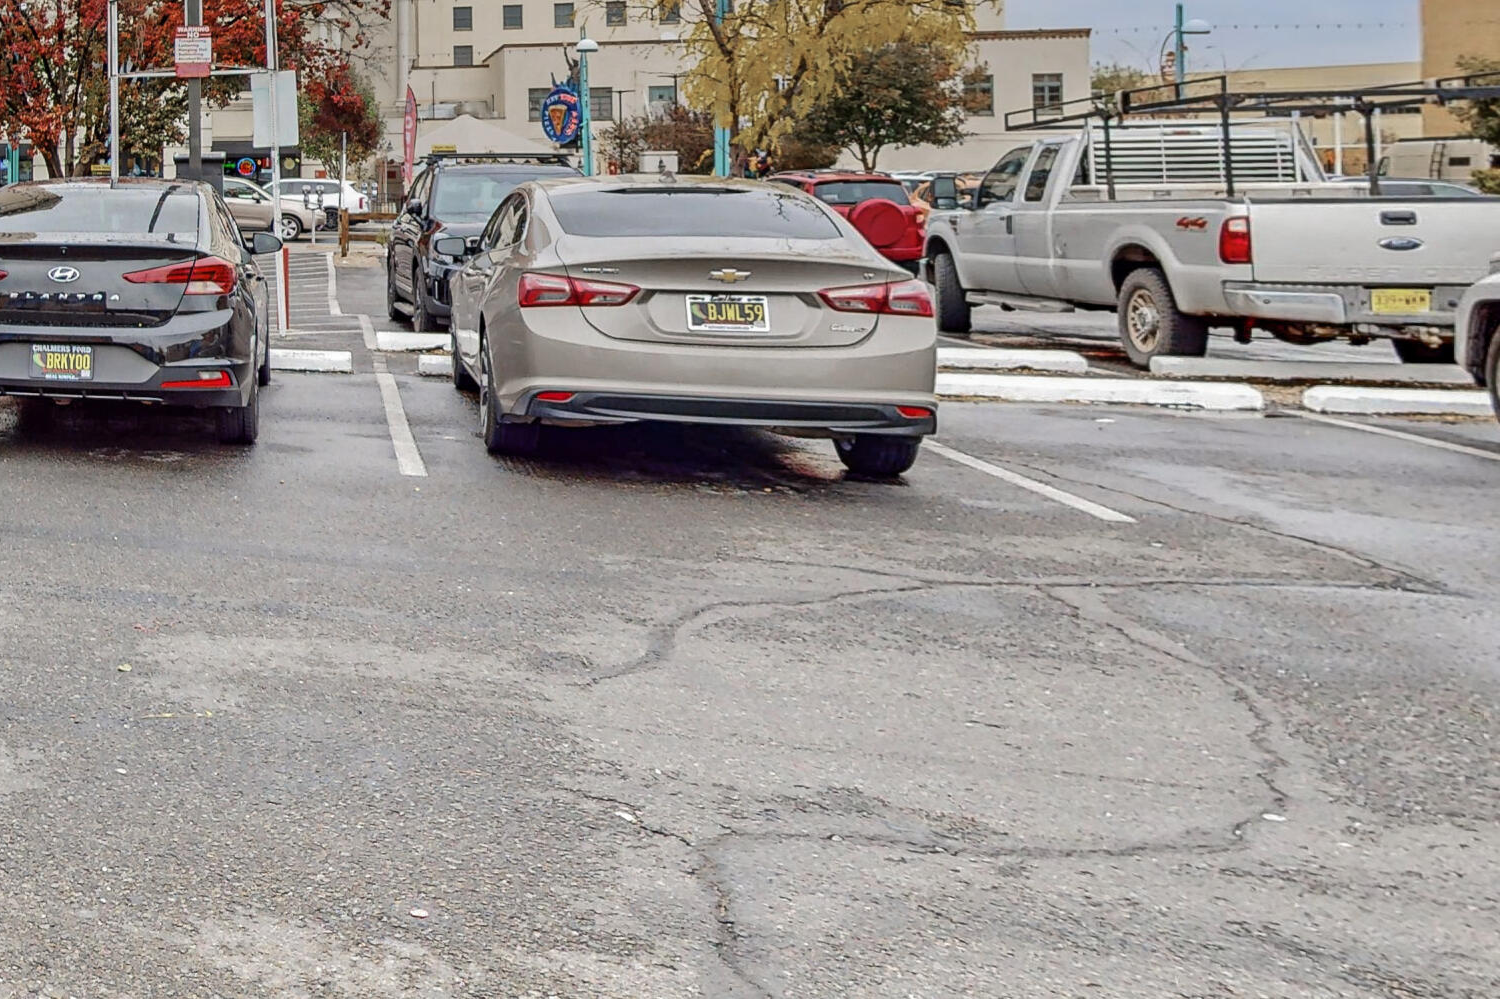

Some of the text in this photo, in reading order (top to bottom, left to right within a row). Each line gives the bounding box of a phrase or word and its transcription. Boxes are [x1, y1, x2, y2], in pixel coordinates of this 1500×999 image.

[9, 291, 120, 301] ELANTRA
[32, 344, 92, 354] CHALMERS FORD
